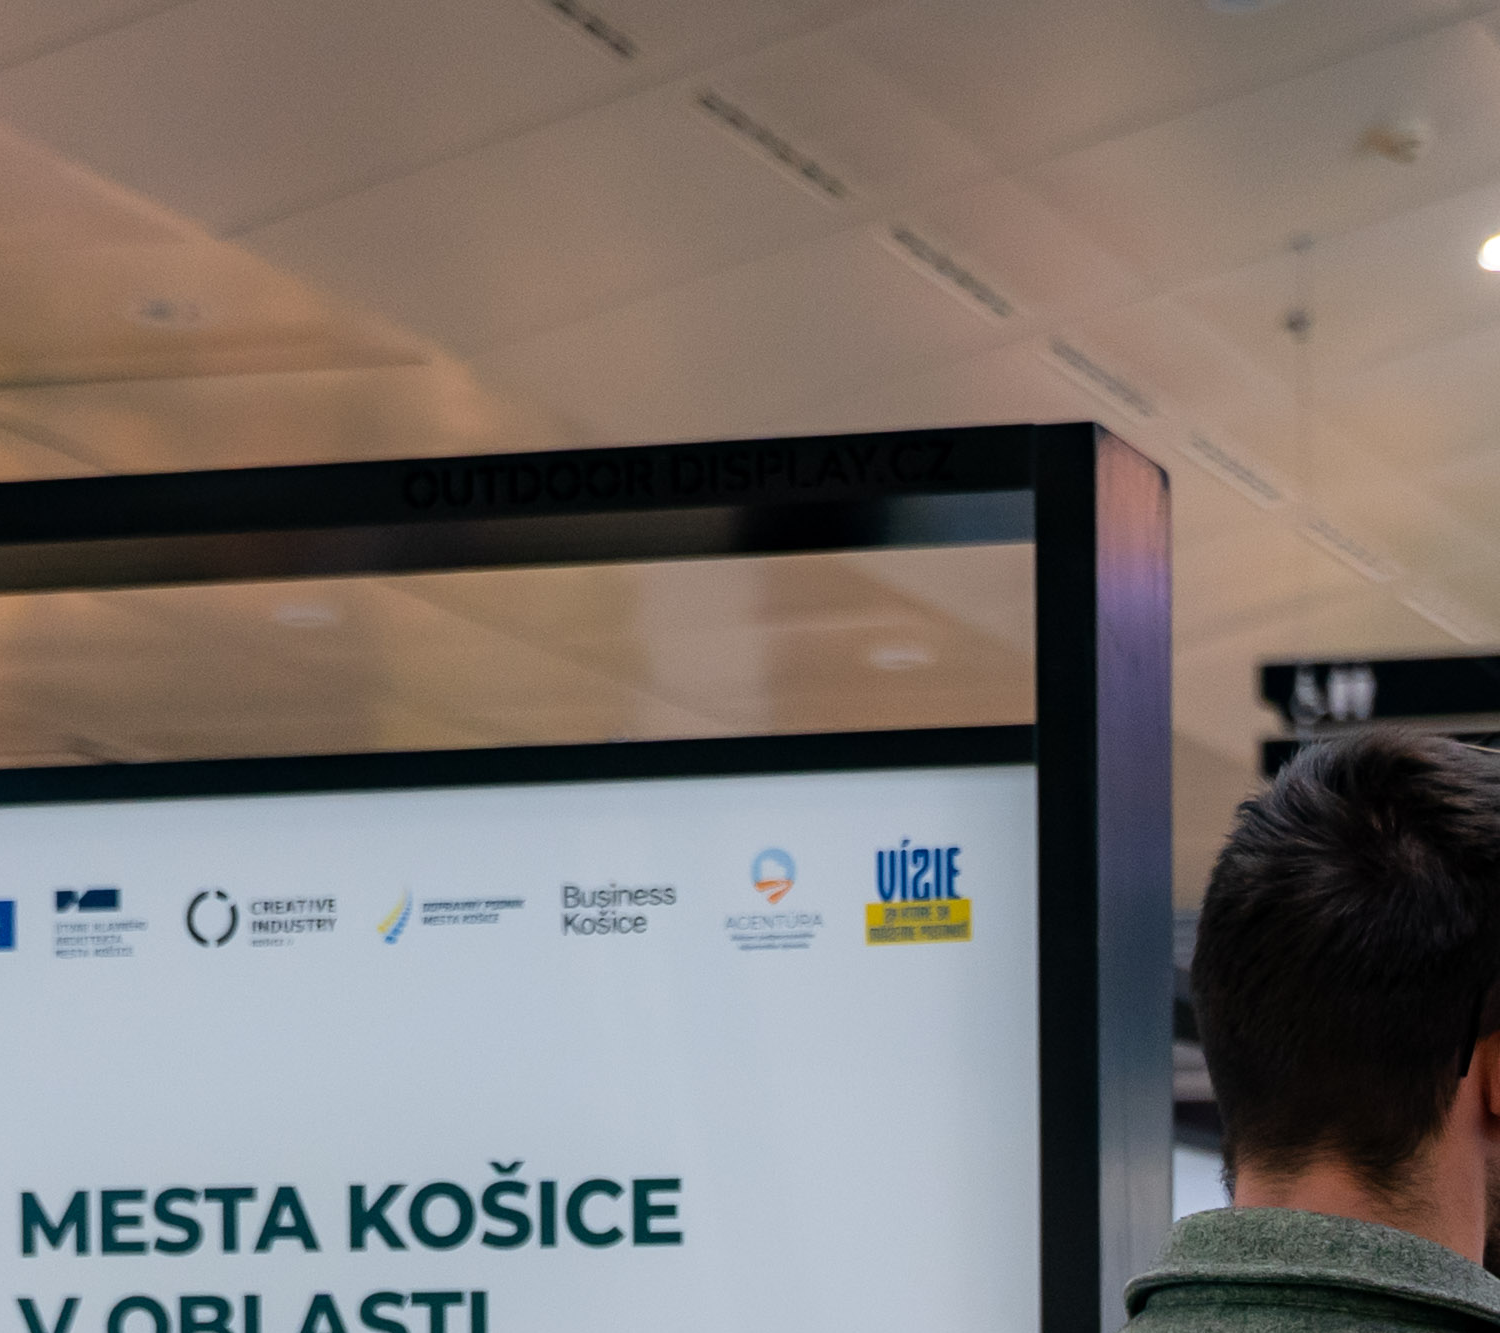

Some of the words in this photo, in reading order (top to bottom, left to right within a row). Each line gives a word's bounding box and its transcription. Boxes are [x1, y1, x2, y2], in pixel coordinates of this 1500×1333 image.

[251, 899, 337, 914] CREATIVE
[563, 883, 676, 908] Business
[252, 918, 337, 933] INDUSTRY
[563, 910, 648, 935] Košice
[21, 1186, 318, 1255] MESTA
[349, 1161, 683, 1252] KOŠICE
